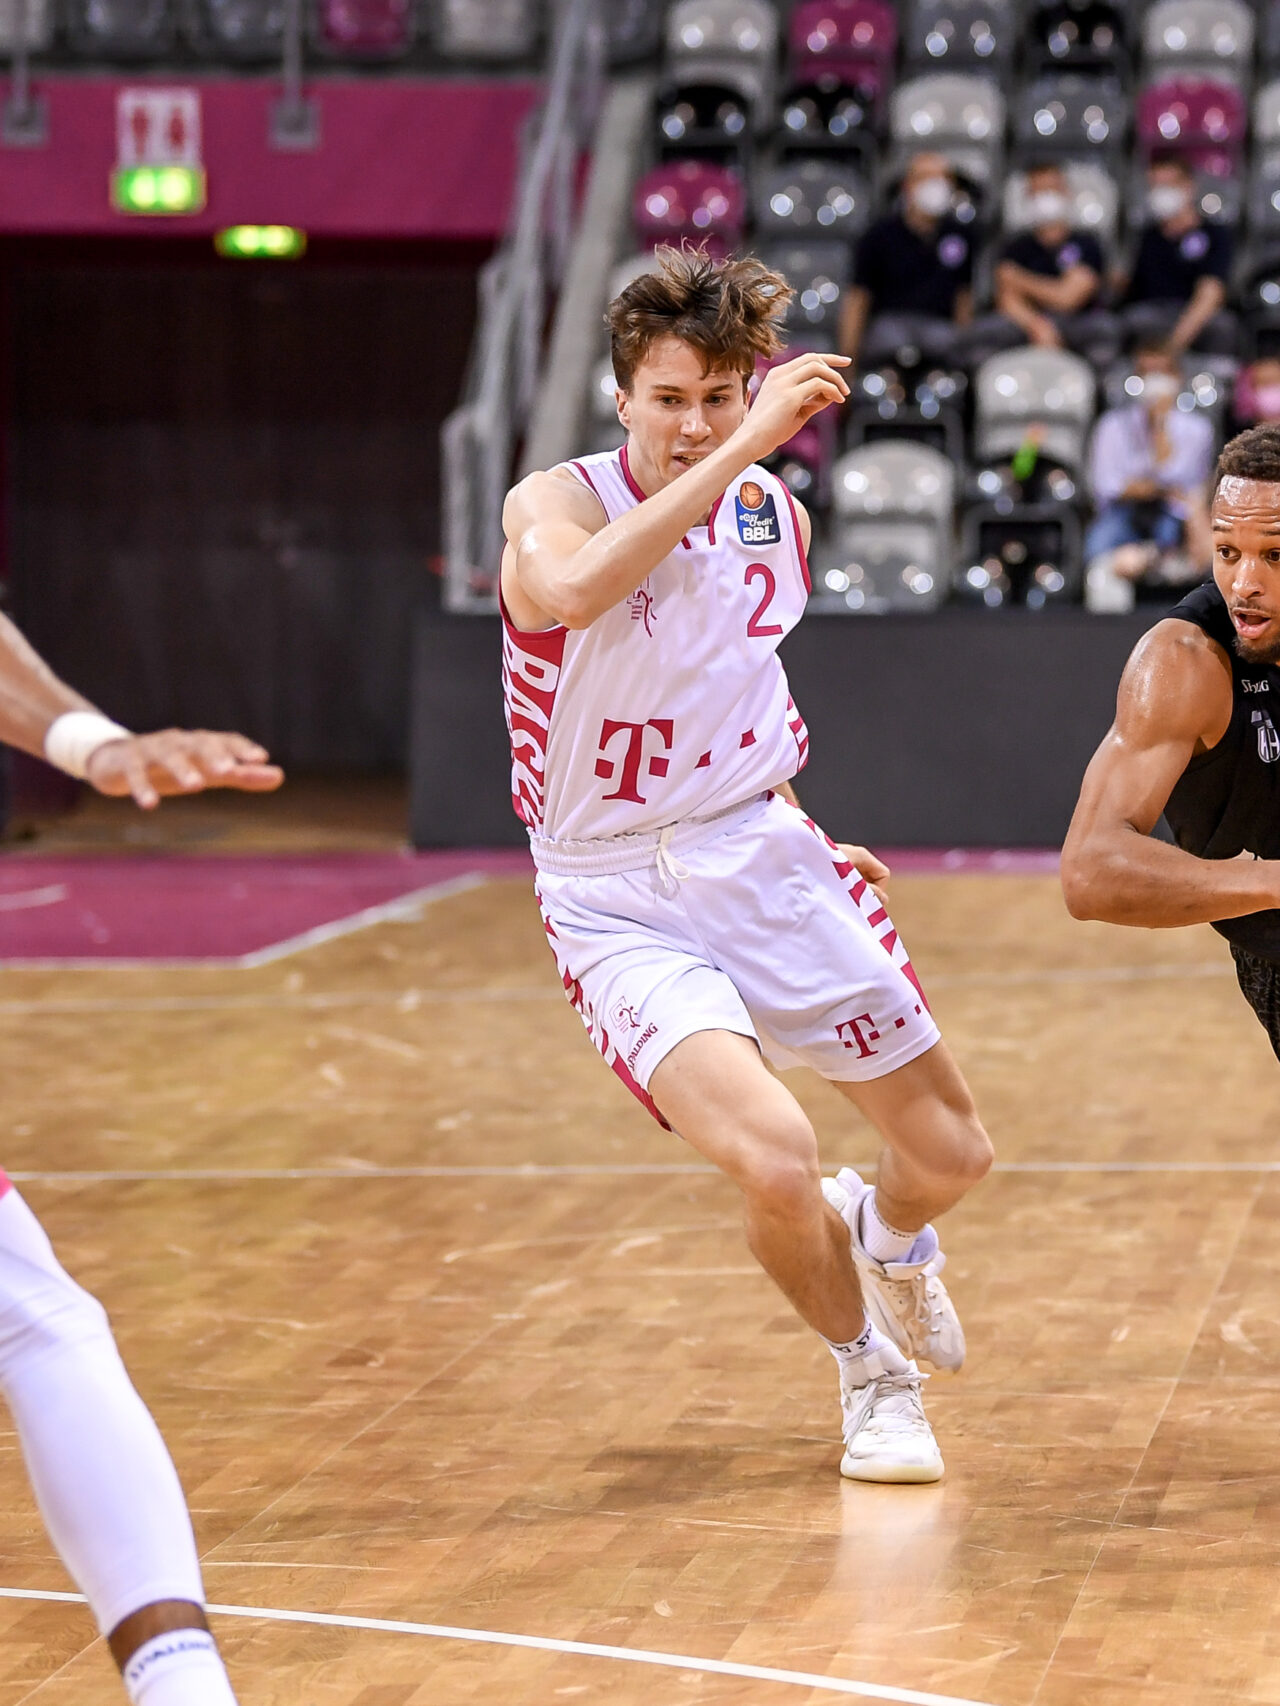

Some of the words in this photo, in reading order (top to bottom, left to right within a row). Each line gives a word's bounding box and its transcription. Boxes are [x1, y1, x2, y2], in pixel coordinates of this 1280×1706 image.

[743, 526, 776, 541] BBL
[744, 563, 783, 637] 2
[595, 718, 674, 804] T
[835, 1012, 880, 1059] T
